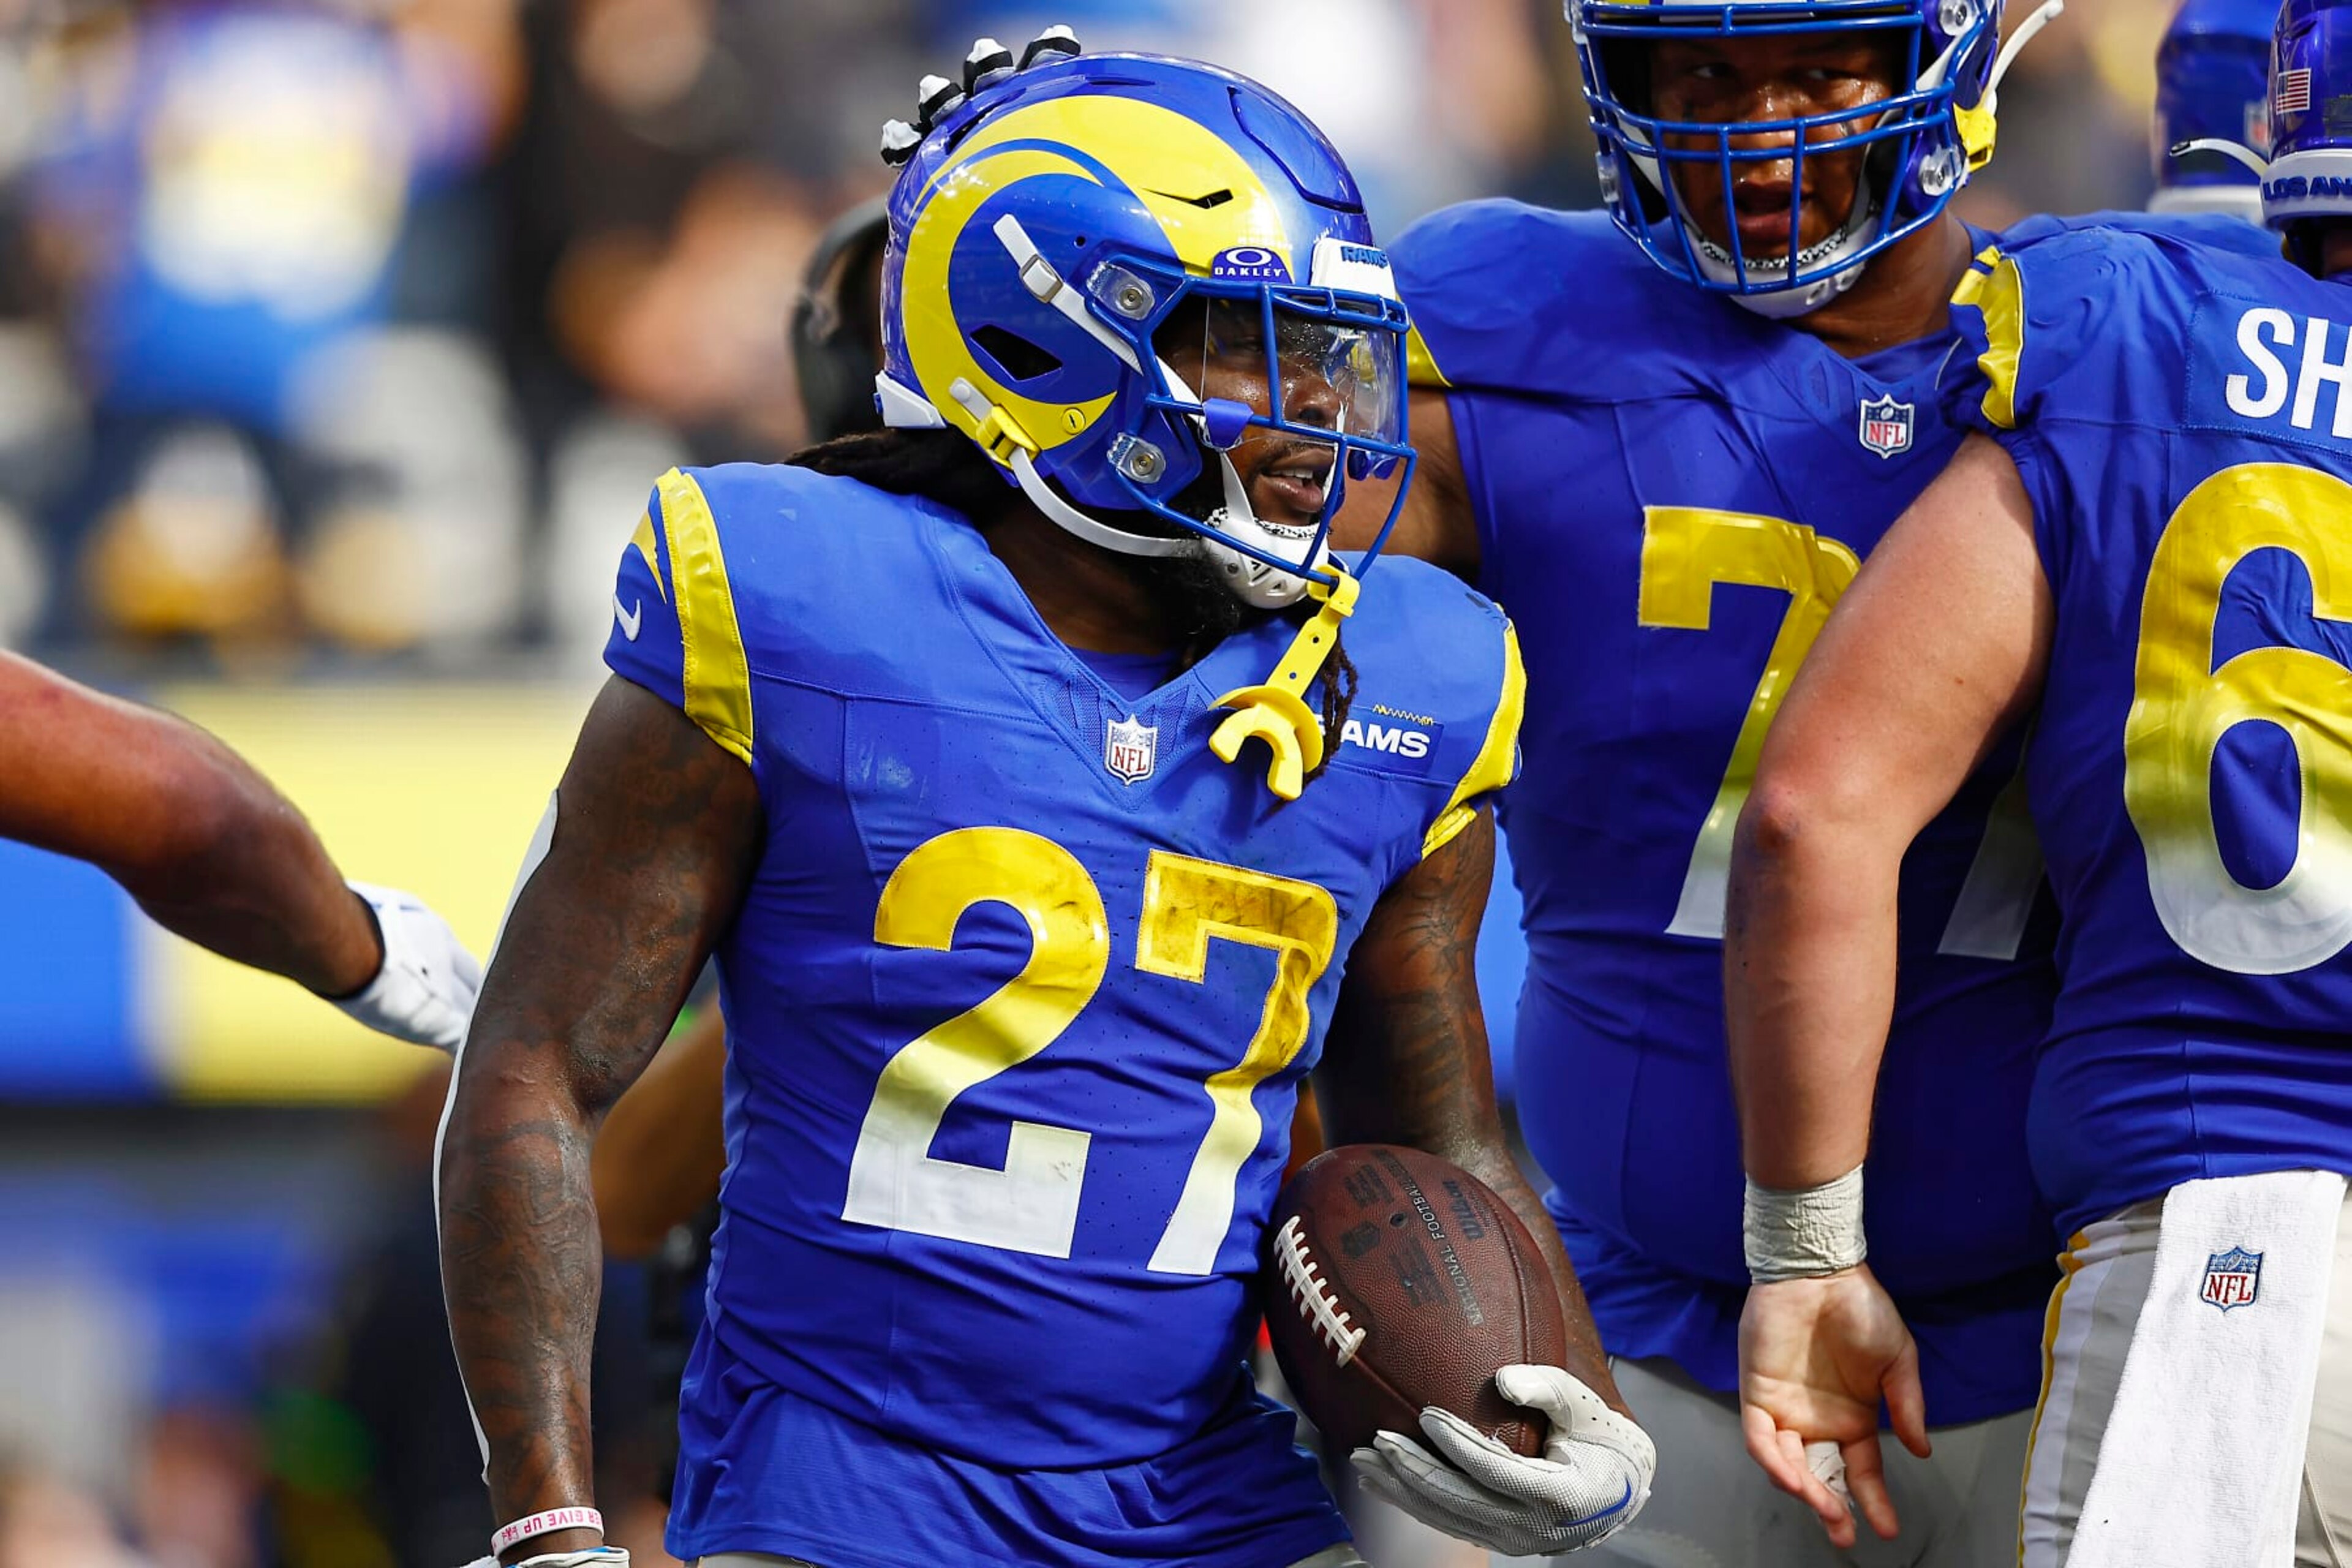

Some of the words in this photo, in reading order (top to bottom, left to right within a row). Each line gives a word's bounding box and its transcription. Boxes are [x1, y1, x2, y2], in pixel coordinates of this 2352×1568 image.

[2263, 176, 2308, 201] LOS
[1341, 246, 1389, 268] RAMS
[1215, 266, 1283, 277] OAKLEY
[2226, 307, 2352, 439] SH
[1869, 423, 1904, 446] NFL
[1315, 714, 1430, 758] AMS
[1113, 745, 1147, 773] NFL
[842, 826, 1338, 1276] 27
[1441, 1245, 1484, 1325] NATIONAL
[2206, 1275, 2252, 1305] NFL
[523, 1517, 543, 1534] UP
[547, 1510, 584, 1527] GIVE
